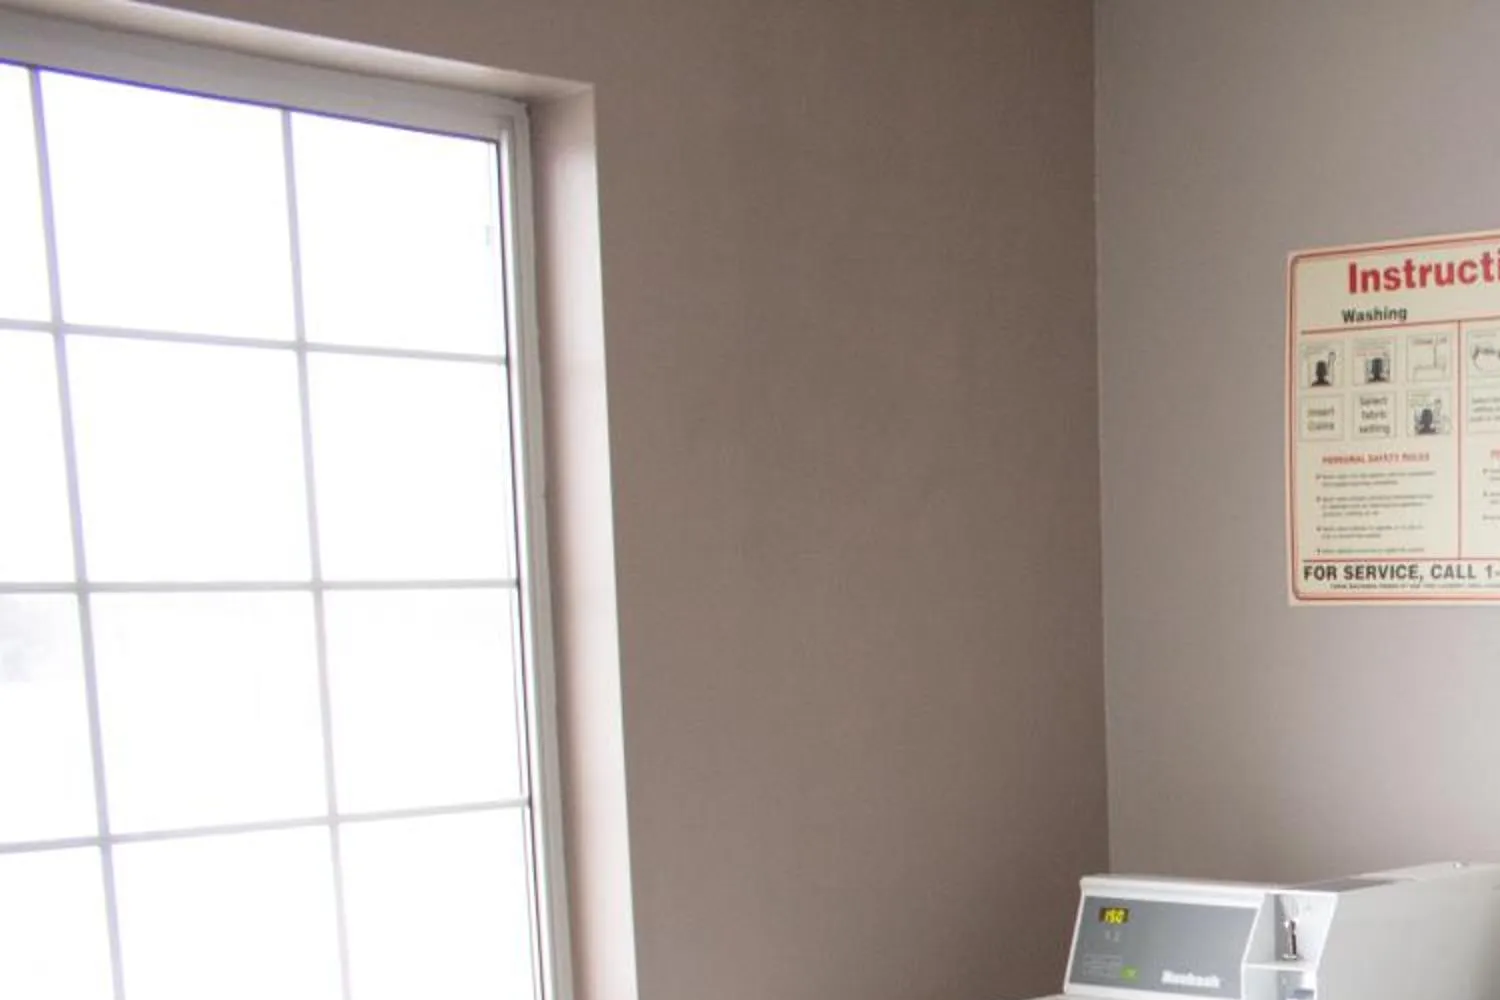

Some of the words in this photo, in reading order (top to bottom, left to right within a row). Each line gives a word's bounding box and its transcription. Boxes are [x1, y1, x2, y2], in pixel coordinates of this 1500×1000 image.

[1341, 306, 1408, 324] Washing
[1303, 564, 1338, 581] FOR
[1343, 563, 1425, 582] SERVICE,
[1431, 563, 1477, 580] CALL
